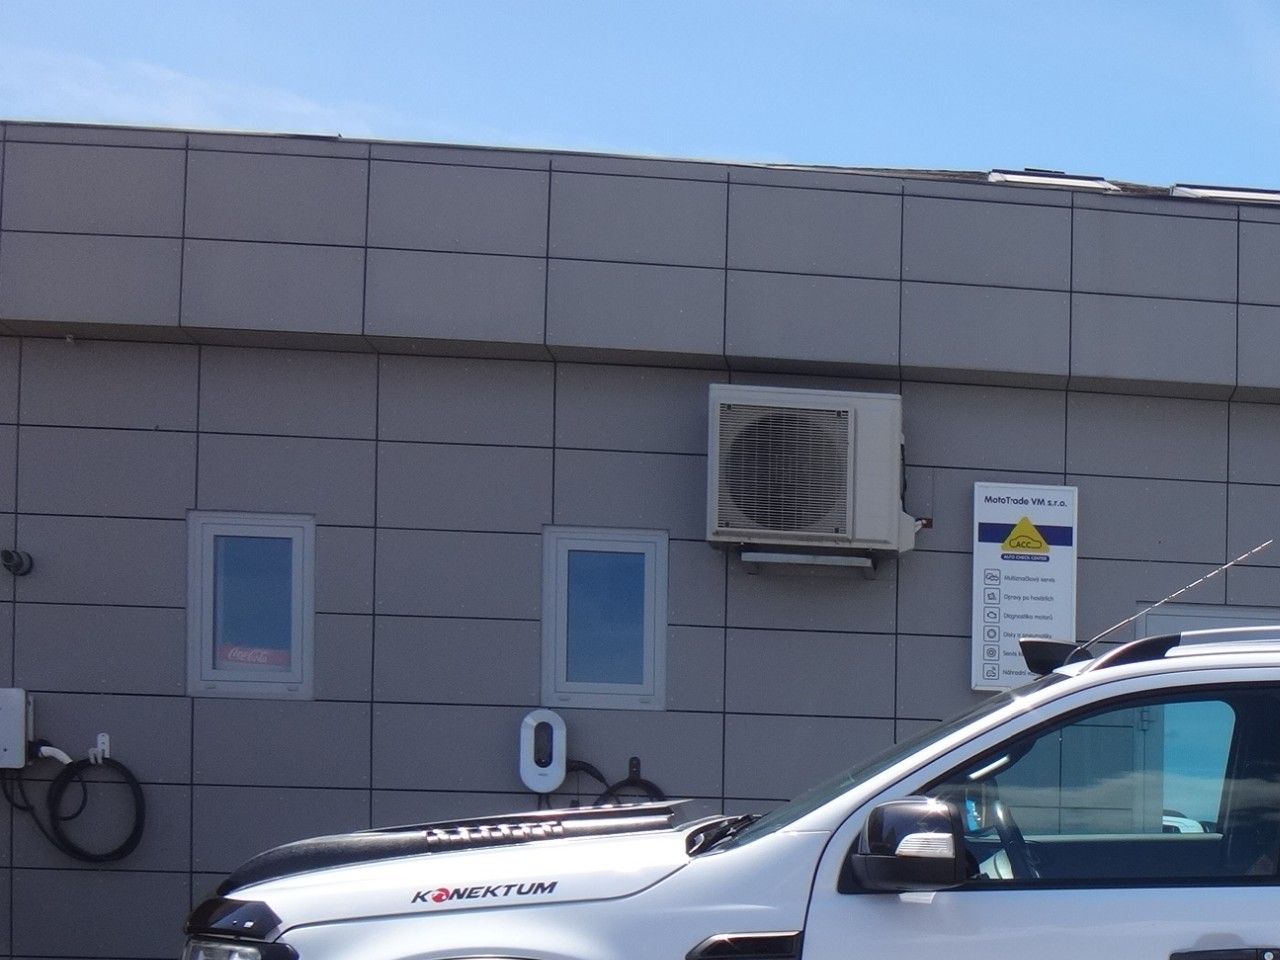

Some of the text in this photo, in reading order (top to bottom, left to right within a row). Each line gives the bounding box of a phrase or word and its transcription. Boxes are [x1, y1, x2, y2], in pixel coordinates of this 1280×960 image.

[984, 496, 1029, 505] MotoTrade
[1031, 498, 1045, 506] VM
[410, 881, 559, 903] KONEKTUM
